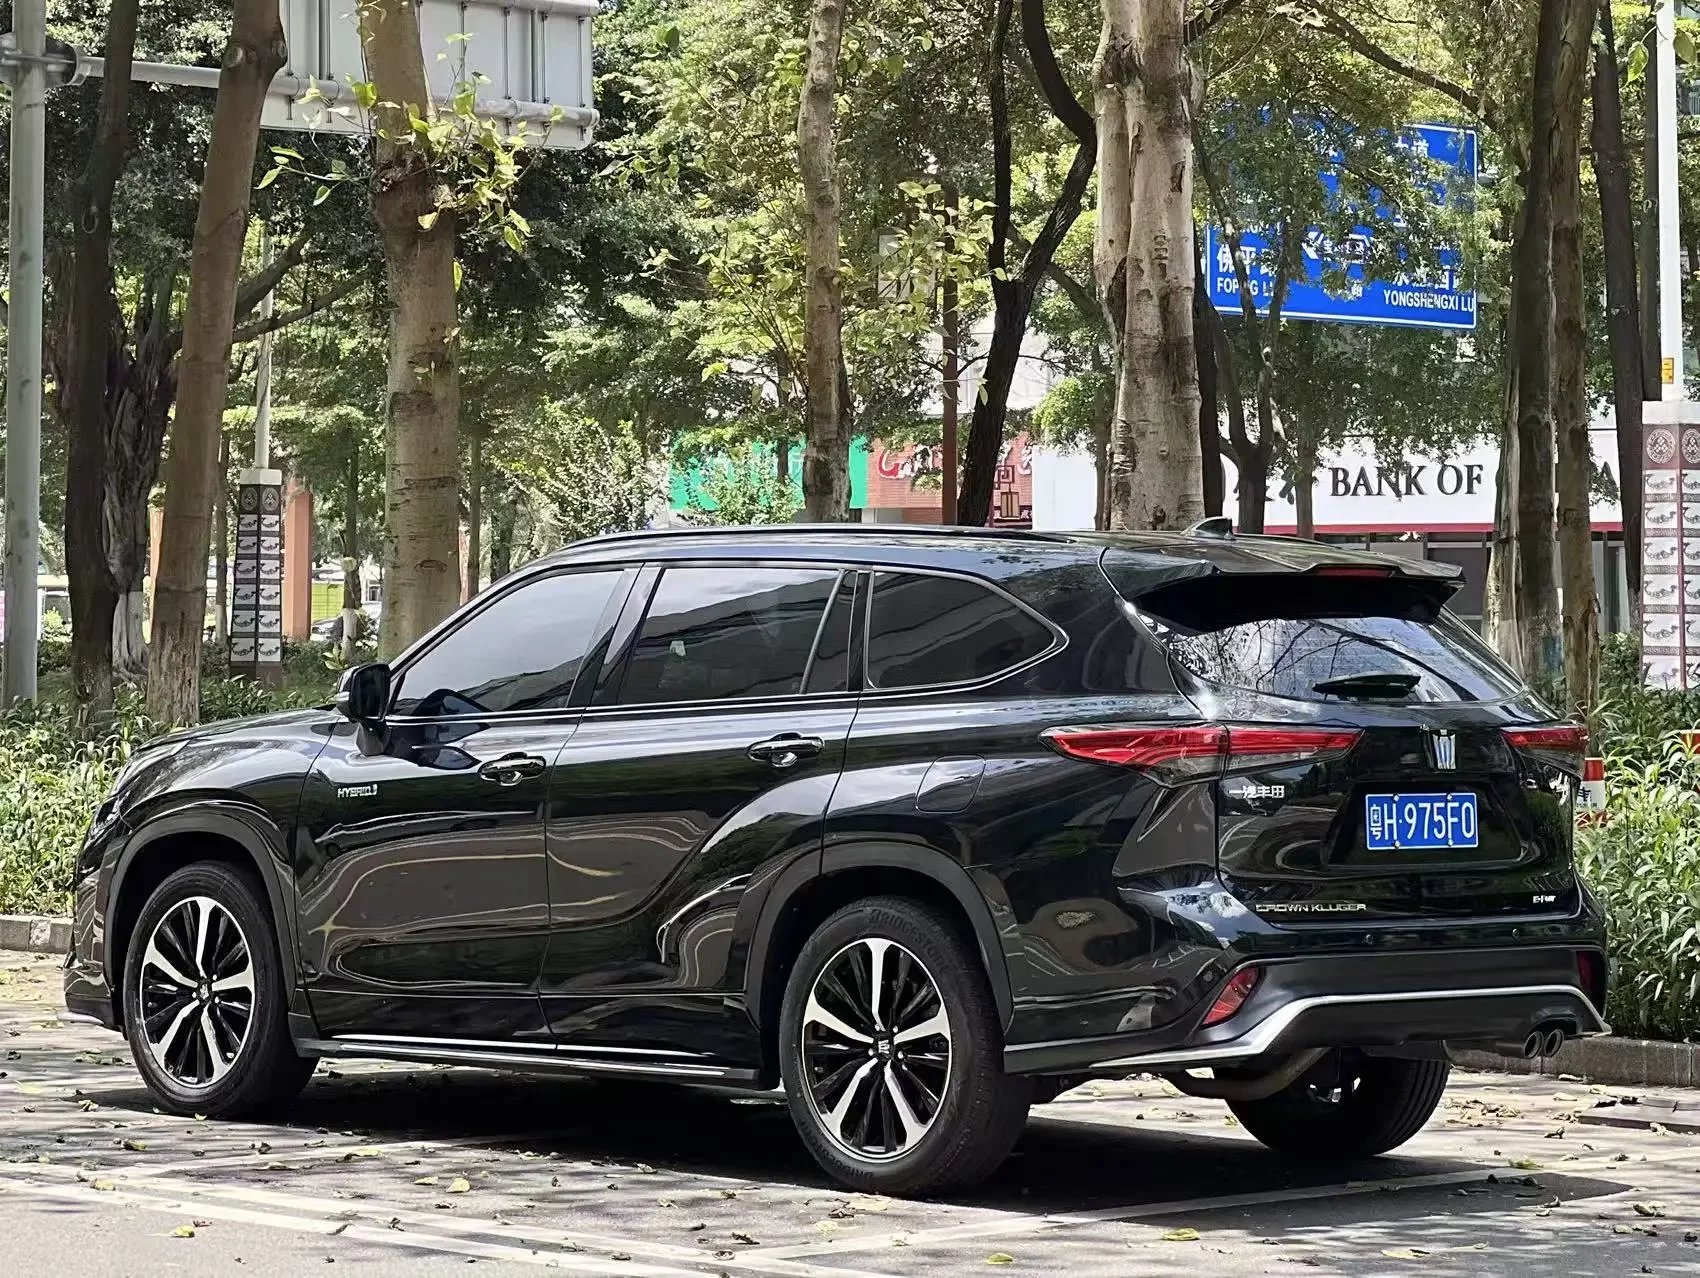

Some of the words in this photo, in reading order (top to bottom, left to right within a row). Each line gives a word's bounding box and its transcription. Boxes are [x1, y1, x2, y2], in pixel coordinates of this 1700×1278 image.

[1217, 277, 1259, 296] FOPG
[1383, 289, 1459, 310] YONGSHENGXI
[1461, 296, 1474, 312] LU
[1328, 465, 1427, 498] BANK
[1436, 464, 1484, 496] OF
[1228, 785, 1285, 799] 一汽丰田
[1255, 903, 1309, 912] CROWN
[1311, 903, 1367, 912] KLUGER
